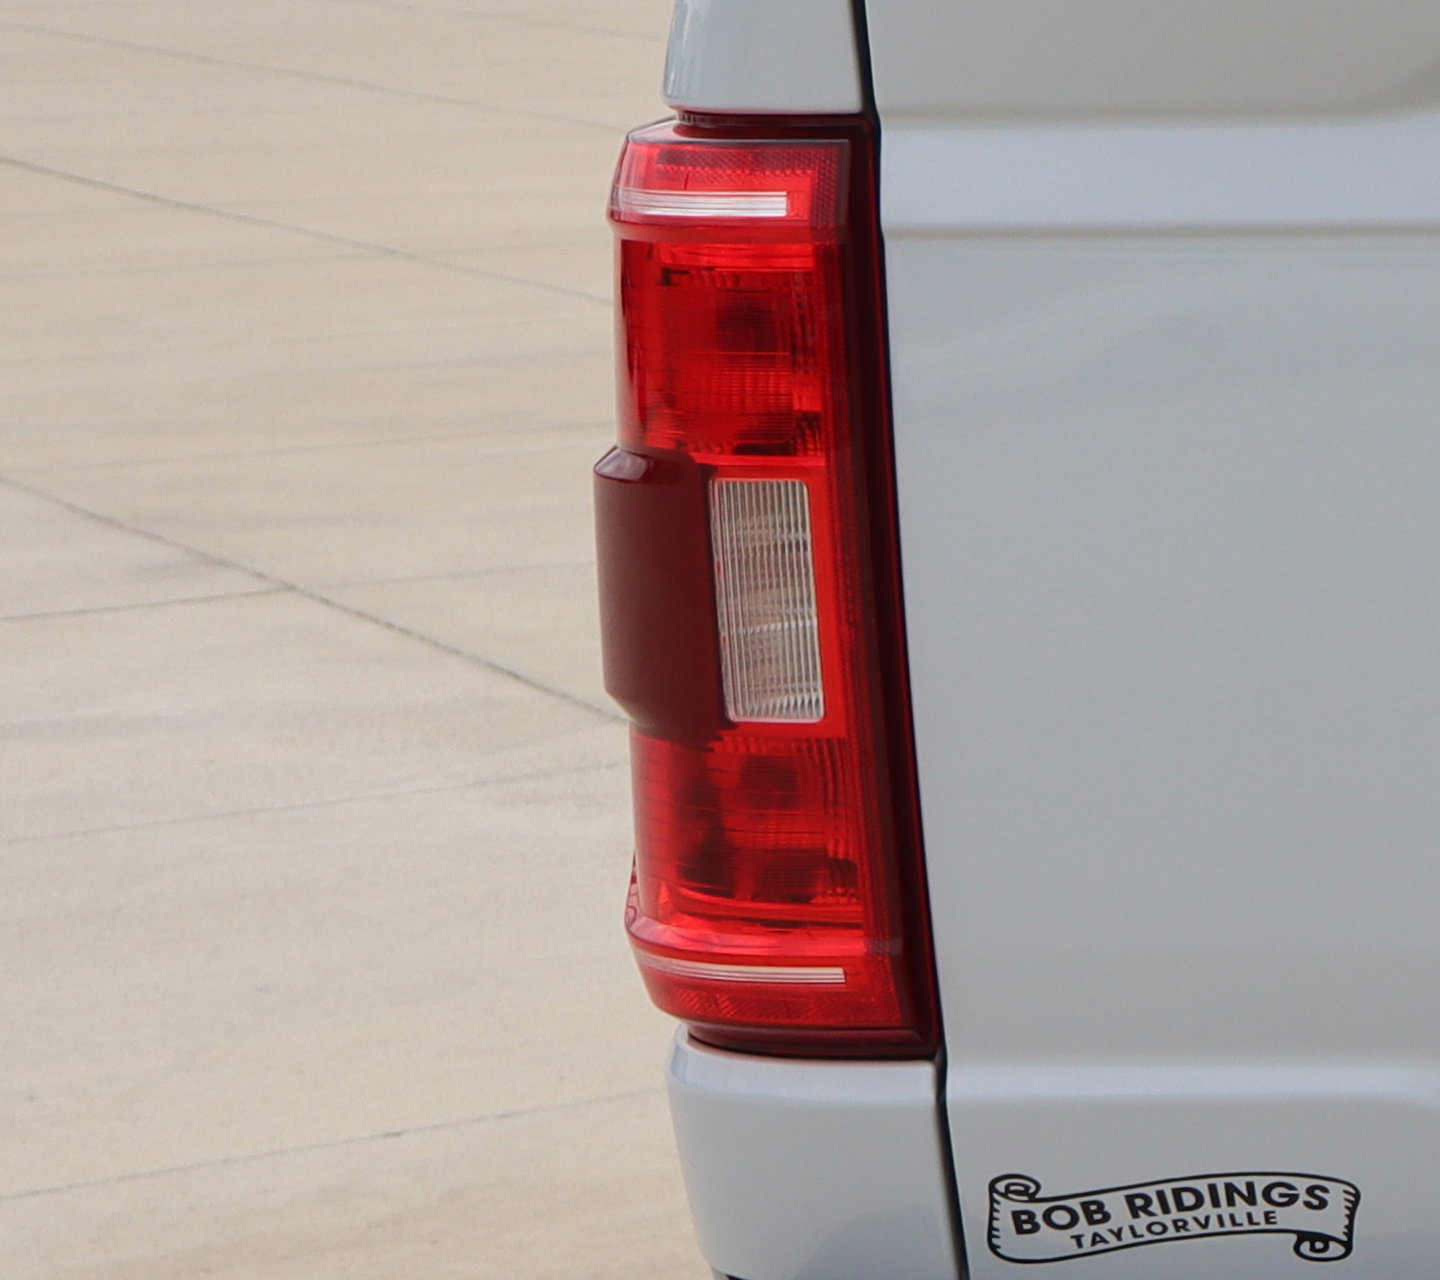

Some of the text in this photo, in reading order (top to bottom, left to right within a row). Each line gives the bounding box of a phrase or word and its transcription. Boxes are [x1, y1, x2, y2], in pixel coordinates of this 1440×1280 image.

[1011, 1181, 1330, 1235] BOB RIDINGS
[1070, 1210, 1278, 1250] TAYLORVILLE
